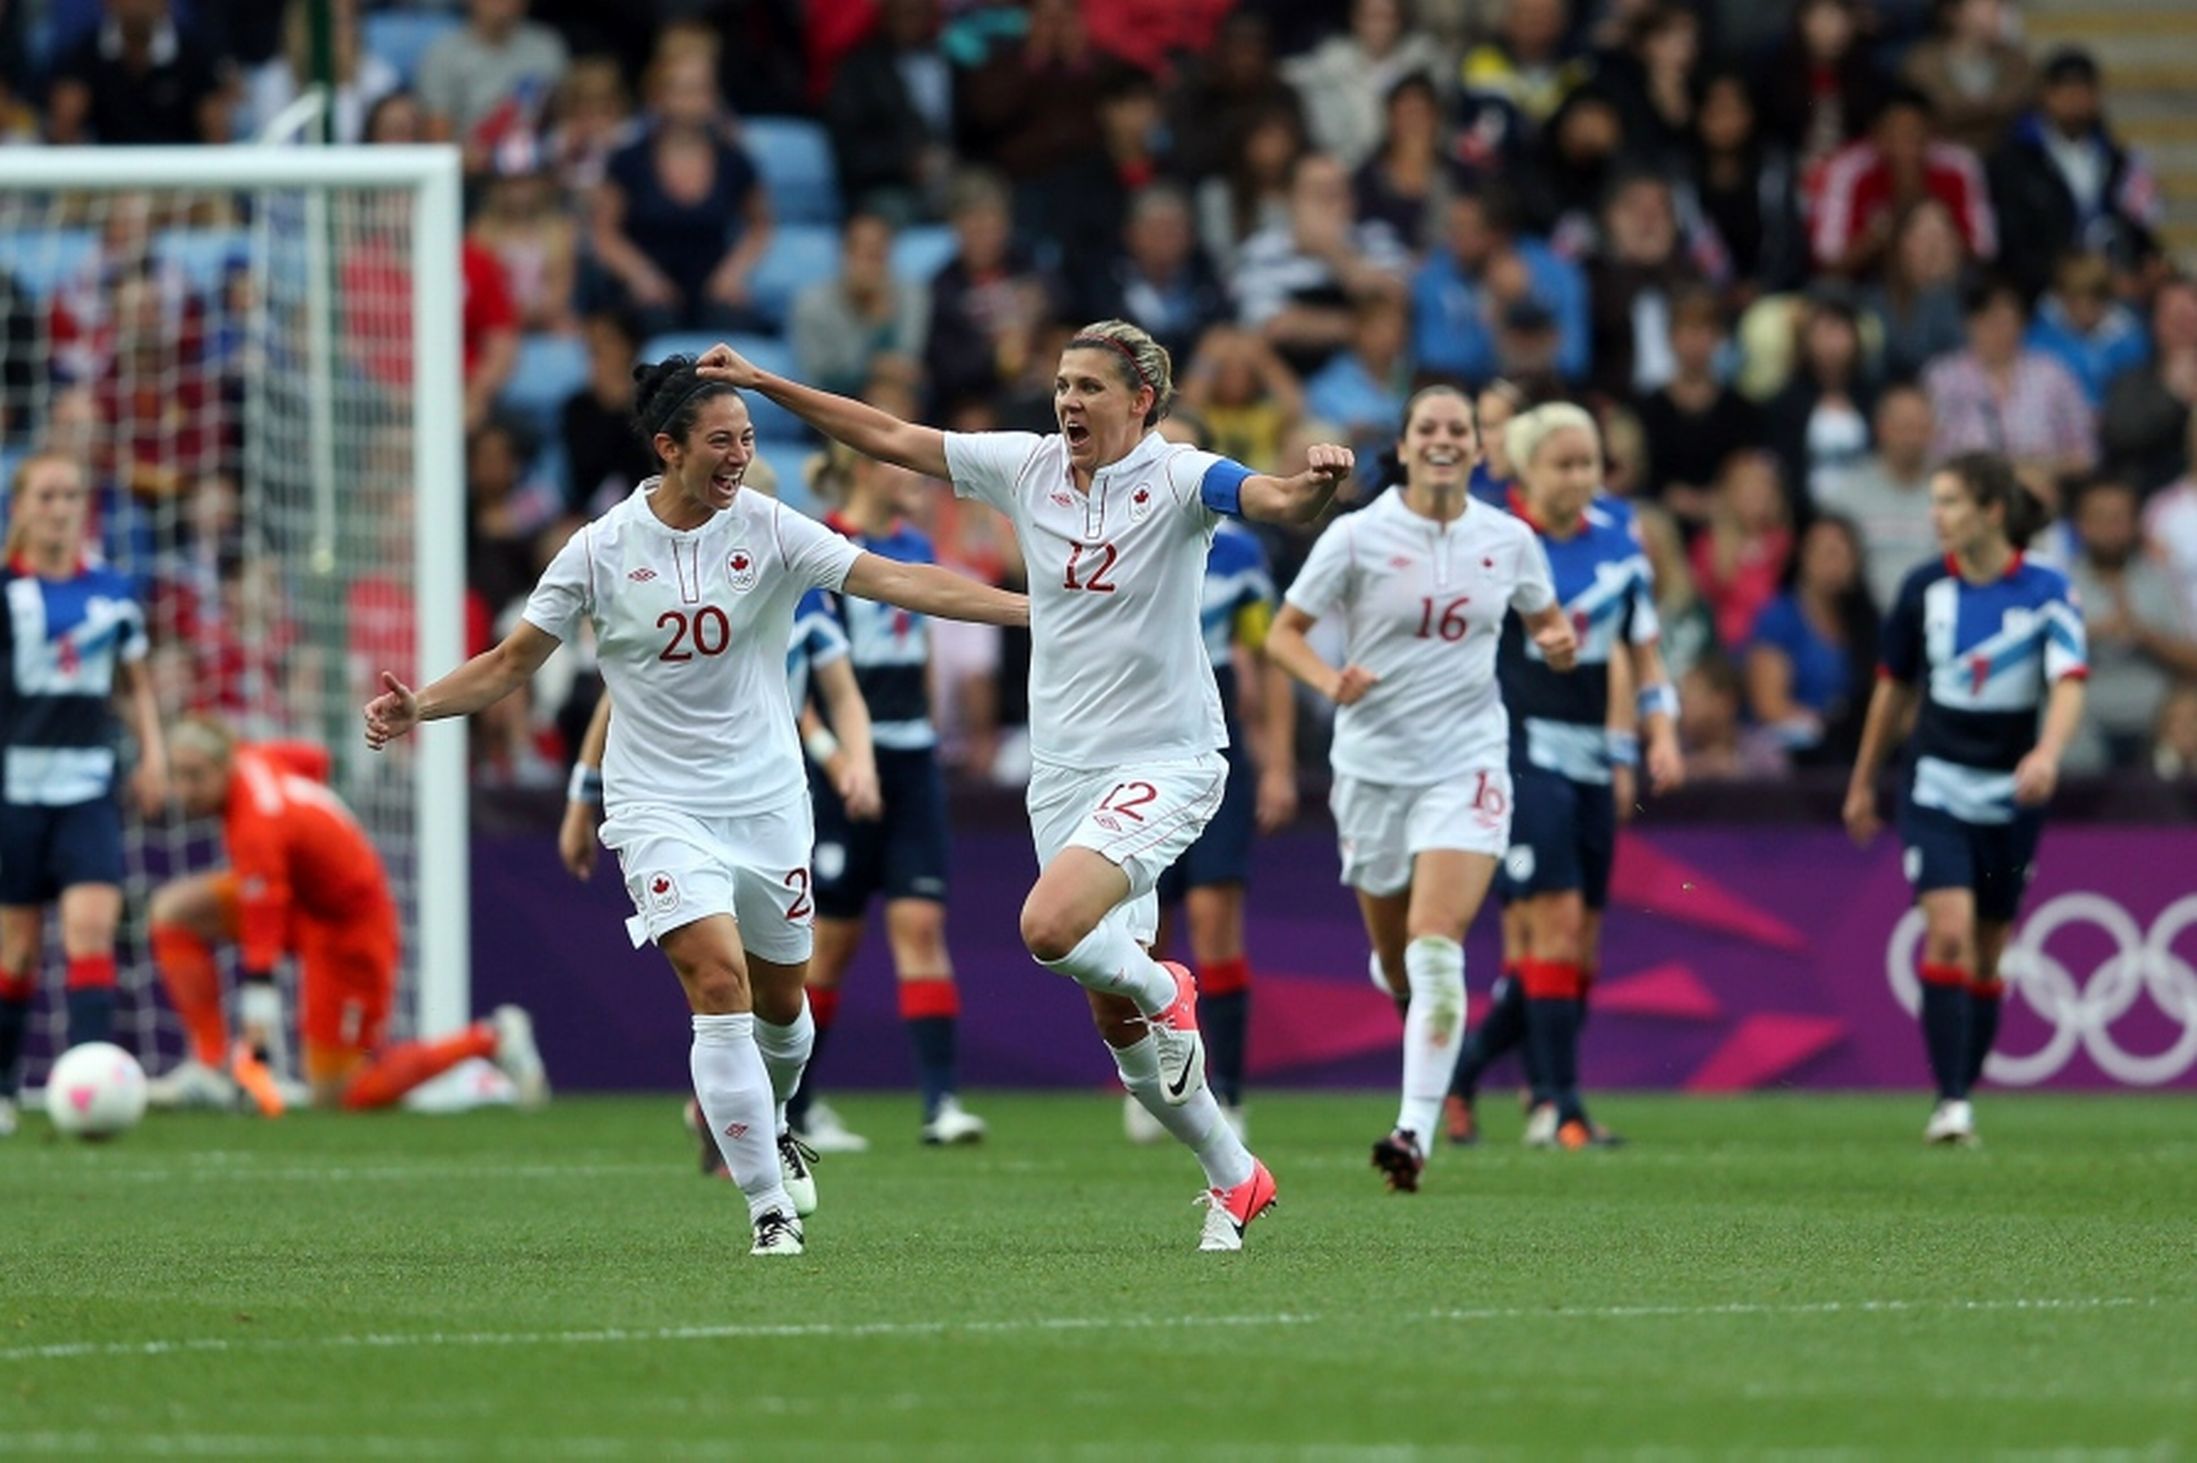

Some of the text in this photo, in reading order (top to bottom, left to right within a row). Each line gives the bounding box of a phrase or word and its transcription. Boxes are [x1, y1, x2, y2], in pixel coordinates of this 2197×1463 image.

[1063, 538, 1118, 592] 12
[656, 605, 731, 663] 20
[1415, 597, 1470, 642] 16
